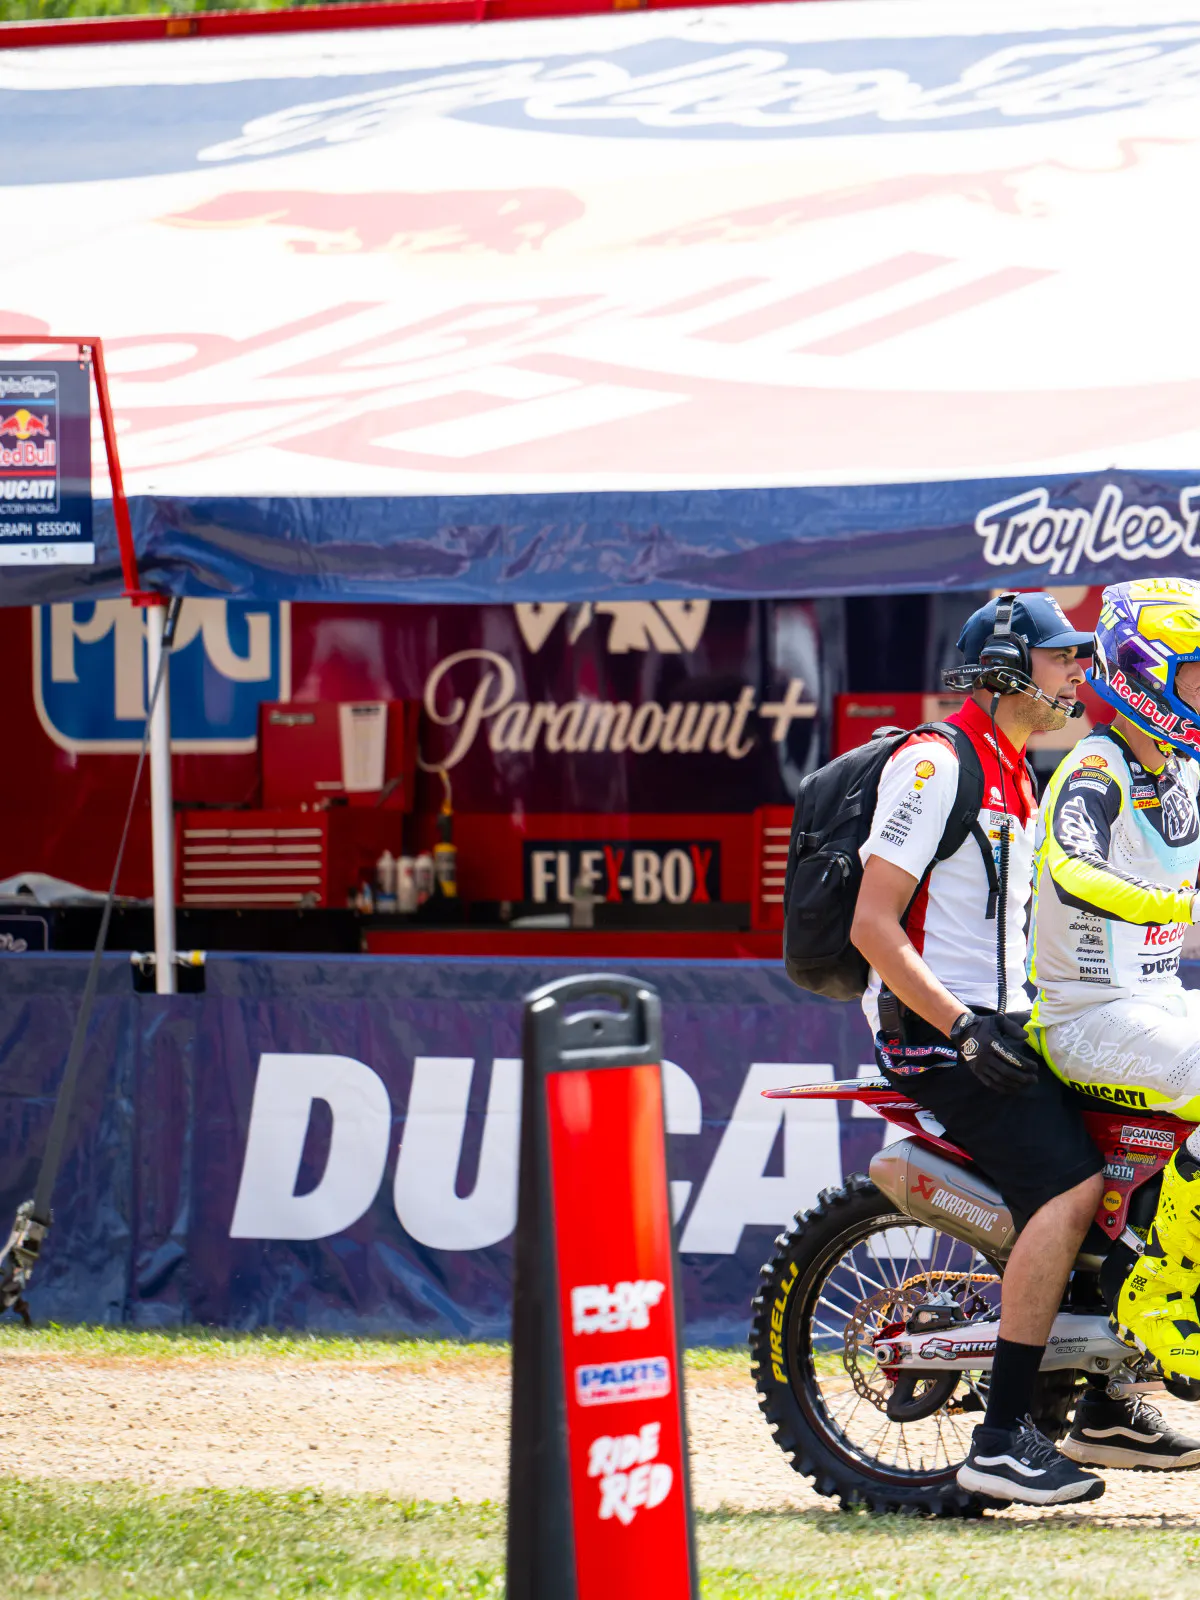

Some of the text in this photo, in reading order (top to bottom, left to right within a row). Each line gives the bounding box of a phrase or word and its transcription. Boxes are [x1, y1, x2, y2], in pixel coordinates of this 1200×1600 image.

[0, 439, 56, 467] ed Bull
[36, 521, 82, 537] SESSION
[975, 486, 1090, 575] Troy
[1084, 483, 1182, 564] Lee
[416, 648, 817, 772] Paramount+
[1110, 669, 1180, 733] Red Bull
[1079, 966, 1109, 975] BN3TH
[1069, 1080, 1148, 1108] DUCATI
[1121, 1136, 1173, 1149] RACING
[1132, 1128, 1174, 1143] GANASSI
[1105, 1197, 1120, 1205] Mips
[769, 1261, 800, 1385] PIRELLI
[1169, 1348, 1199, 1356] SIDI
[581, 1361, 667, 1387] PARTS
[587, 1420, 662, 1479] RIDE
[598, 1462, 674, 1527] RED
